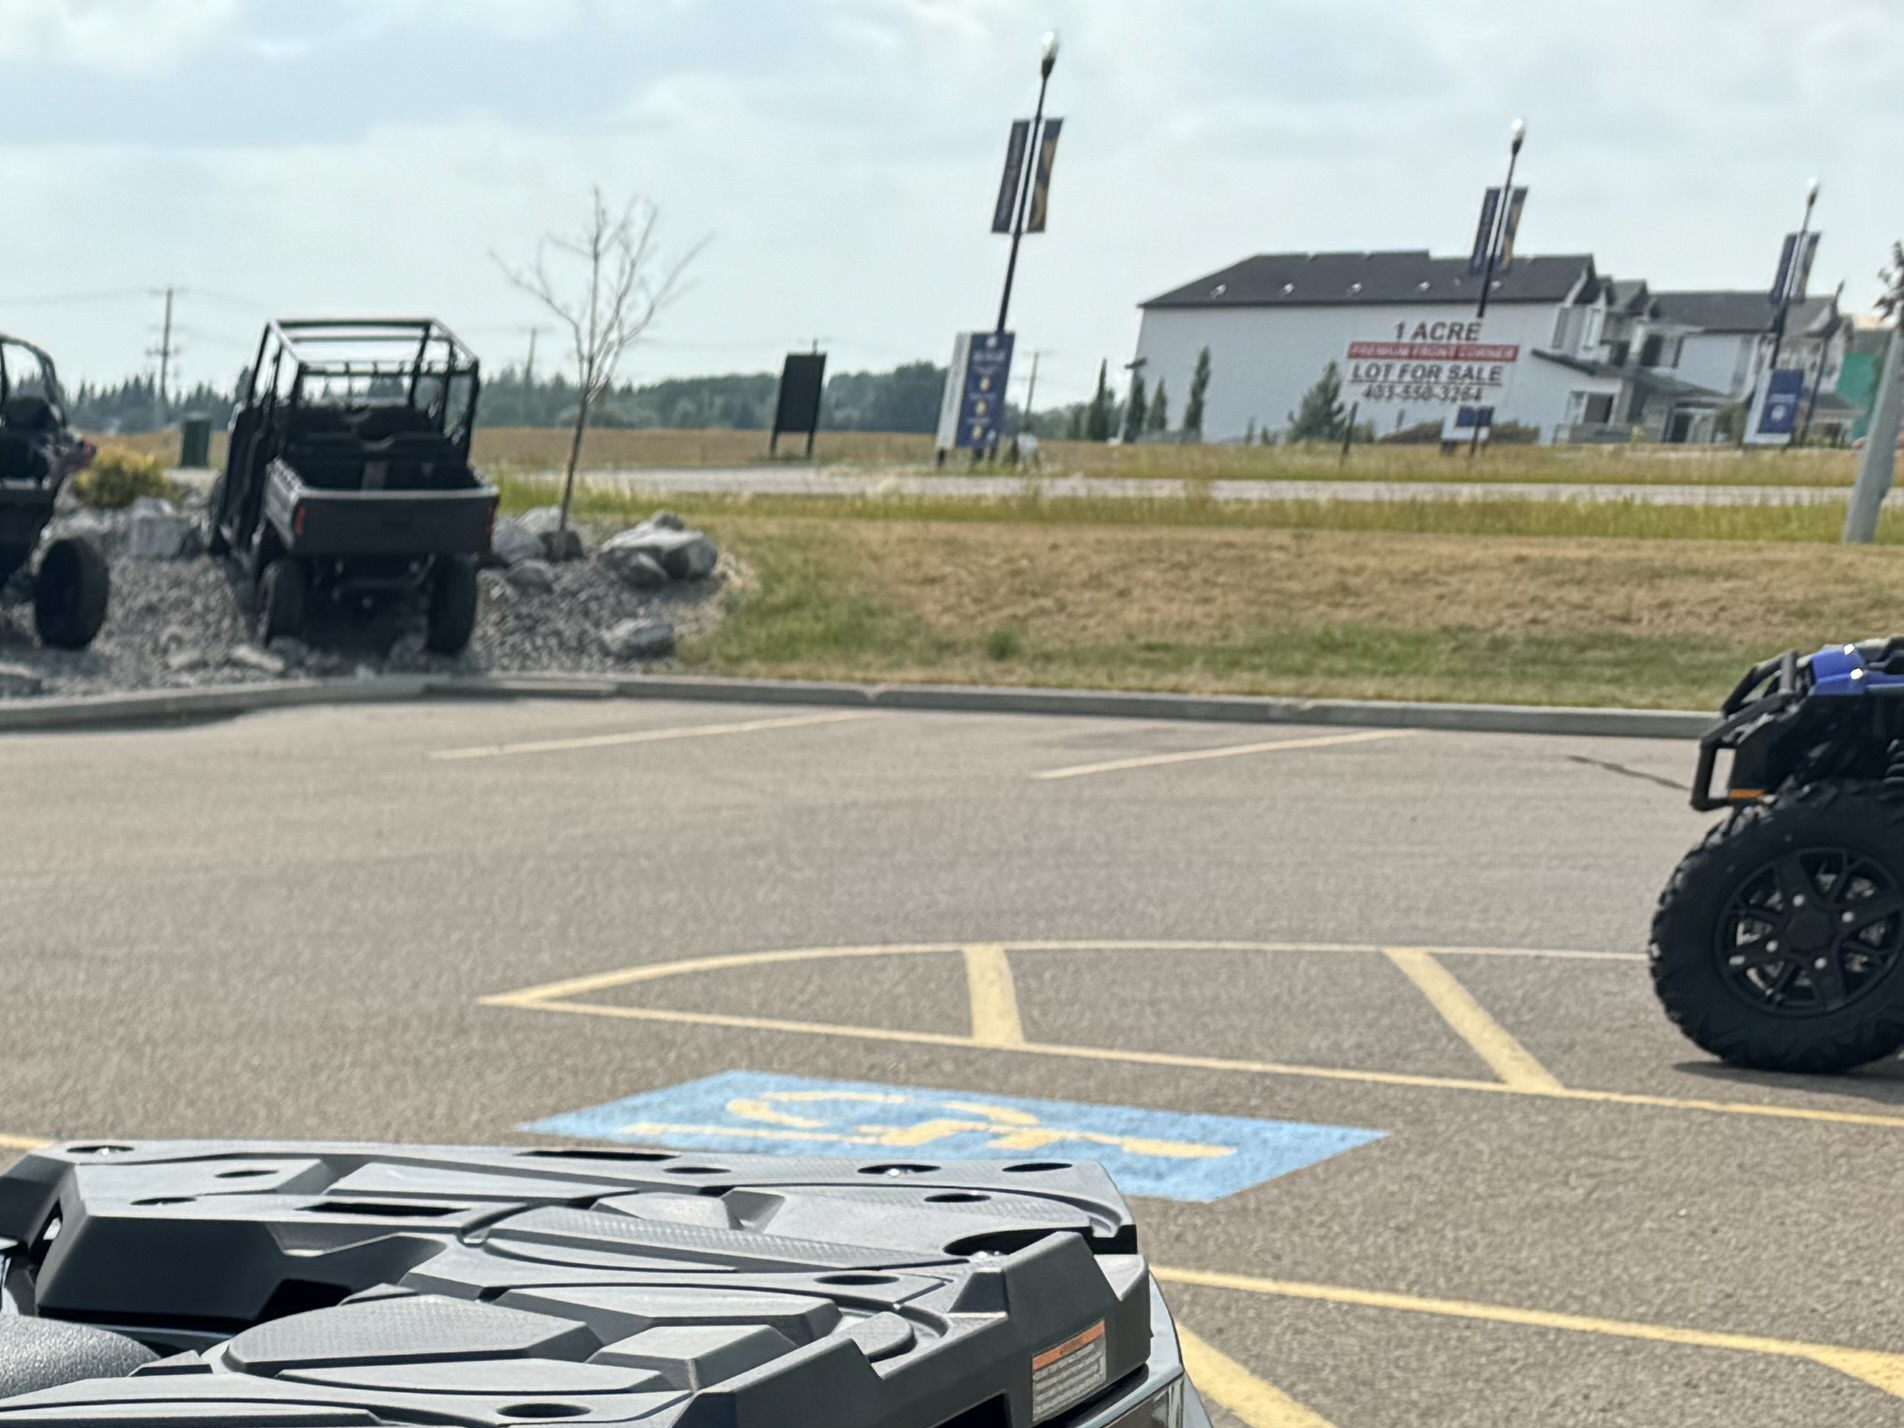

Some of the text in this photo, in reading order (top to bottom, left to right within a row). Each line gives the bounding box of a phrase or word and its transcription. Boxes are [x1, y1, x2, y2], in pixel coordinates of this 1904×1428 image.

[1395, 322, 1481, 341] 1 ACRE
[1352, 364, 1502, 381] LOT FOR SALE
